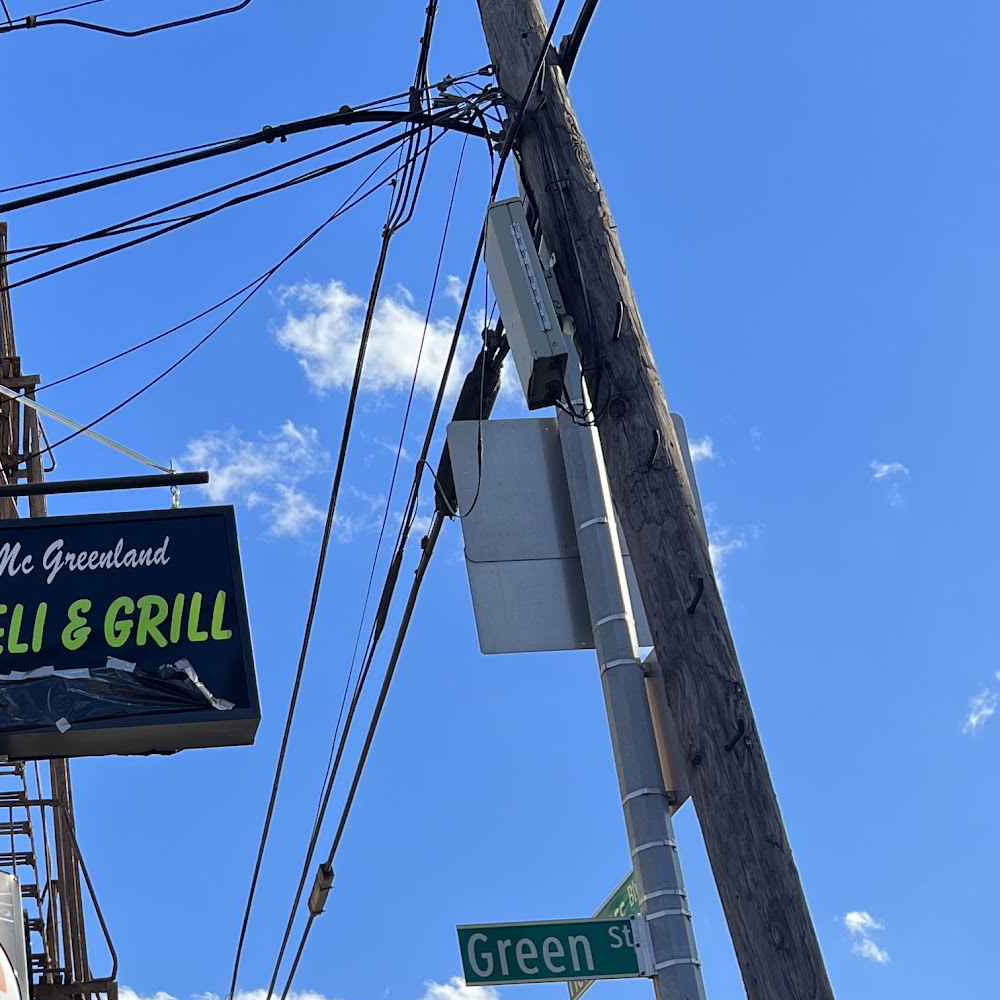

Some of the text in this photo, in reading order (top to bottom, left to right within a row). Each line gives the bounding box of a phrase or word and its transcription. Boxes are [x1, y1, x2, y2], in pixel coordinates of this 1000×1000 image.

[42, 535, 171, 585] Greenland
[60, 598, 93, 651] &
[103, 589, 233, 649] GRILL
[467, 925, 635, 978] Green St
